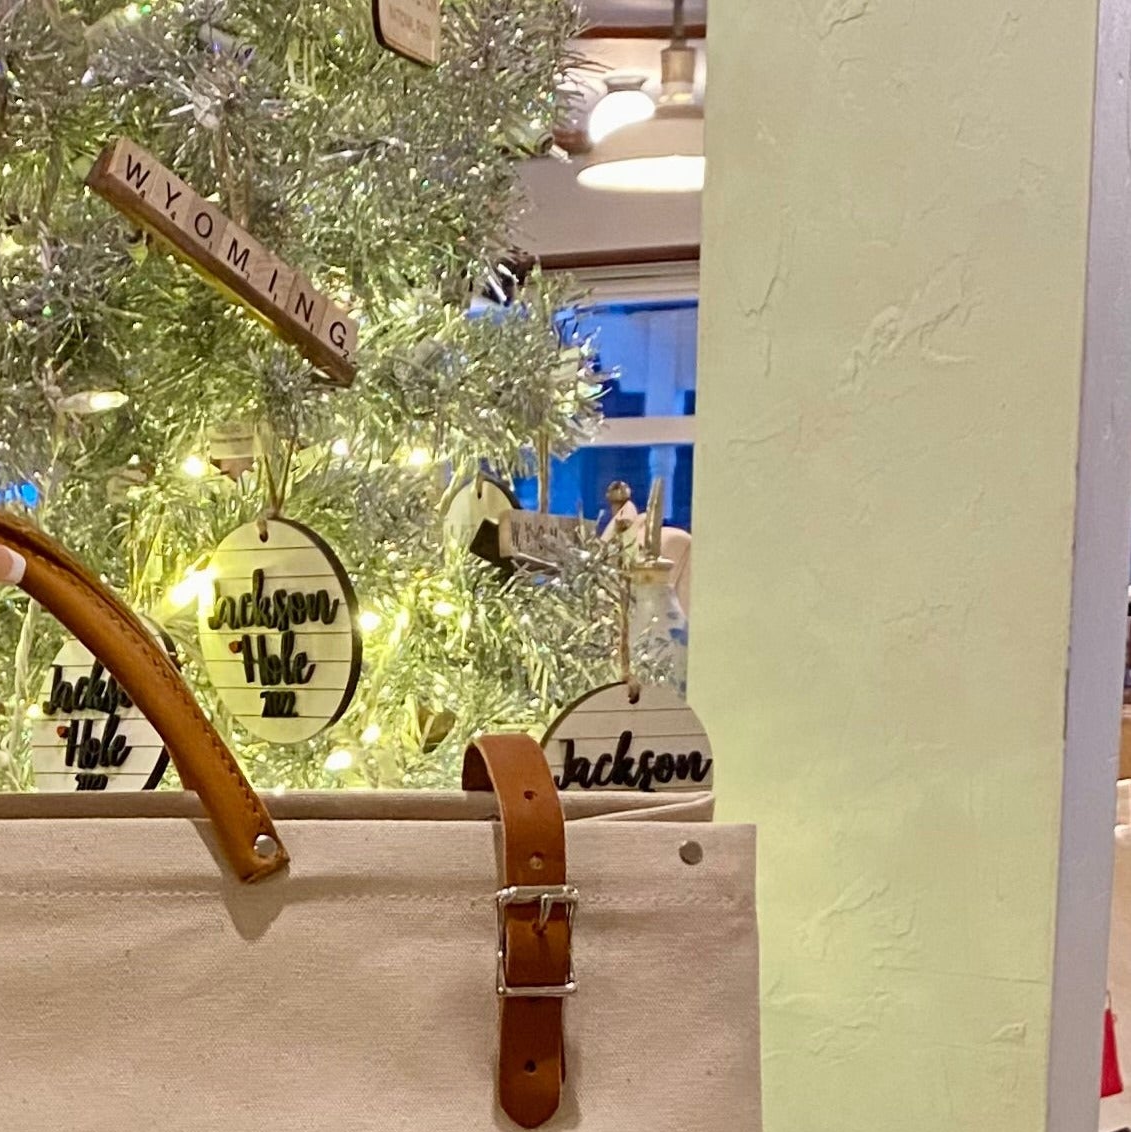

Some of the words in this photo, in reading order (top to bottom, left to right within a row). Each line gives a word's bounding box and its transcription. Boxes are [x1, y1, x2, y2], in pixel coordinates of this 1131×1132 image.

[125, 153, 348, 350] WYOMING
[208, 568, 340, 631] Jackson
[42, 659, 134, 715] Jacks
[241, 630, 317, 686] Hole
[64, 713, 133, 769] Hole
[553, 730, 714, 792] Jackson
